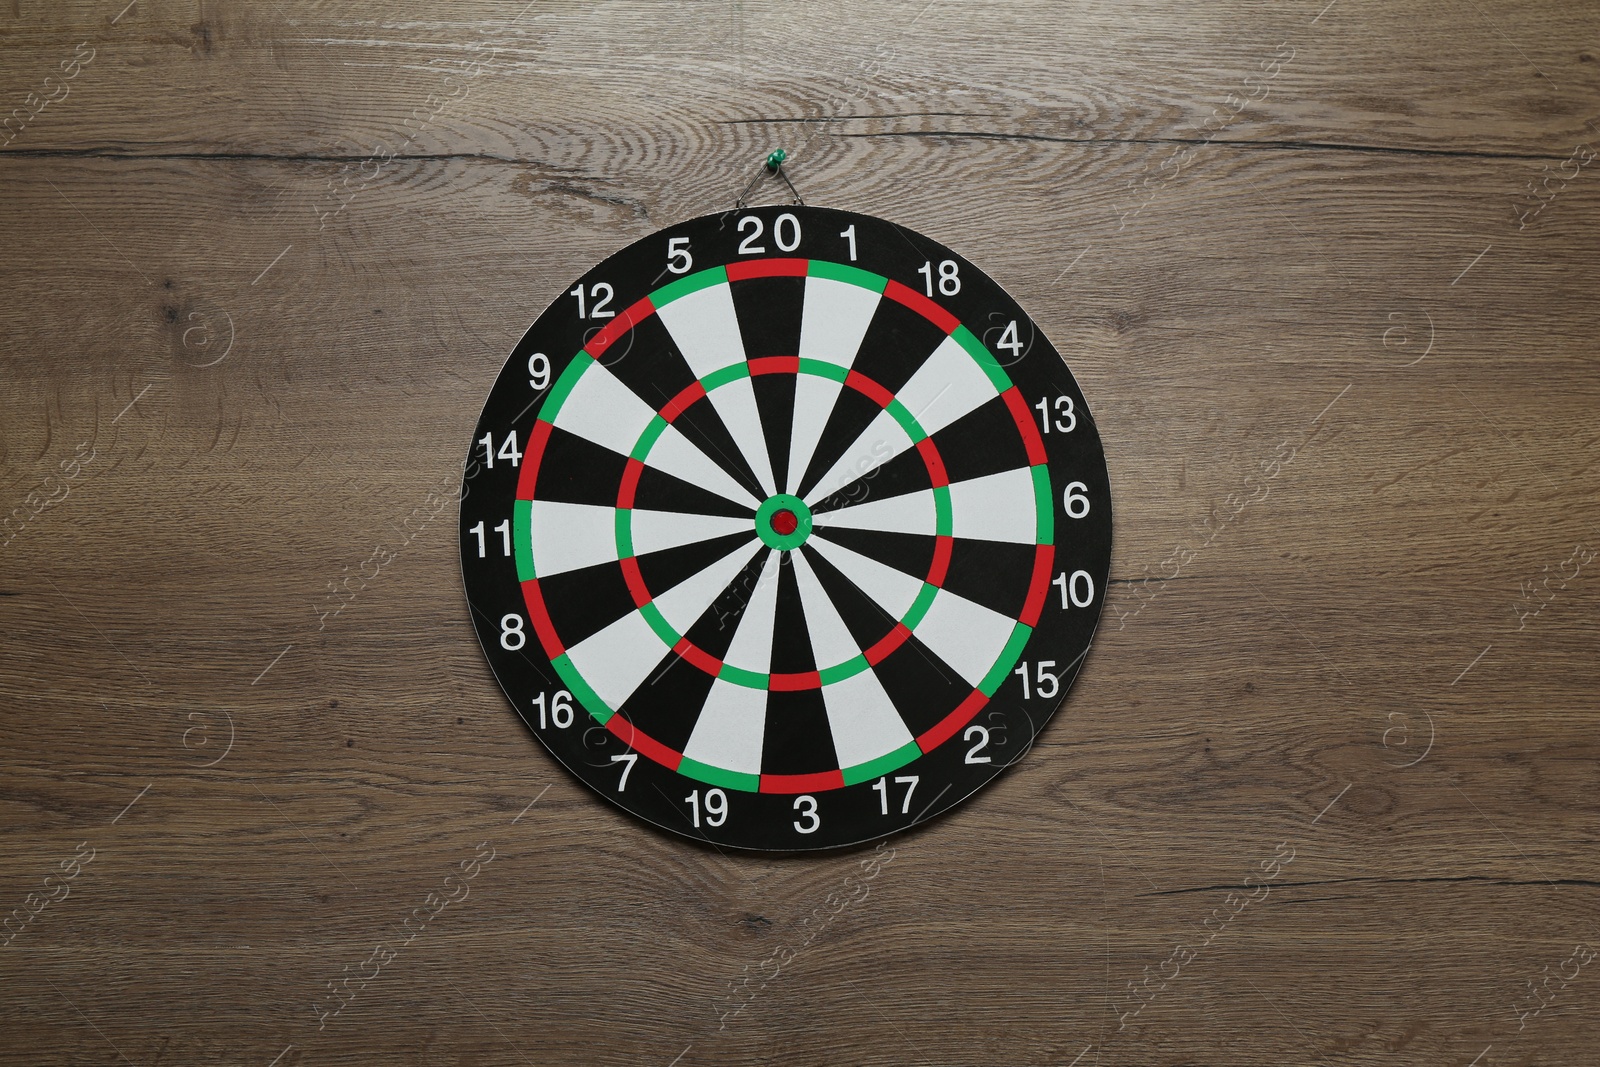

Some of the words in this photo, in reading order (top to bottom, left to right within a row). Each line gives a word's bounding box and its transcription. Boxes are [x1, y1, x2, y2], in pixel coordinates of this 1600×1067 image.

[737, 213, 802, 255] 20
[840, 224, 857, 262] 1
[666, 236, 693, 274] 5
[917, 259, 961, 298] 18
[570, 282, 616, 319] 12
[996, 320, 1024, 357] 4
[528, 352, 551, 391] 9
[1035, 395, 1077, 434] 13
[478, 430, 523, 469] 14
[1063, 481, 1091, 519] 6
[469, 519, 511, 558] 11
[1052, 569, 1095, 610] 10
[500, 613, 526, 651] 8
[1014, 660, 1059, 700] 15
[532, 690, 574, 730] 16
[963, 725, 992, 765] 2
[610, 753, 638, 792] 7
[684, 788, 728, 828] 19
[793, 795, 821, 834] 3
[872, 775, 920, 815] 17
